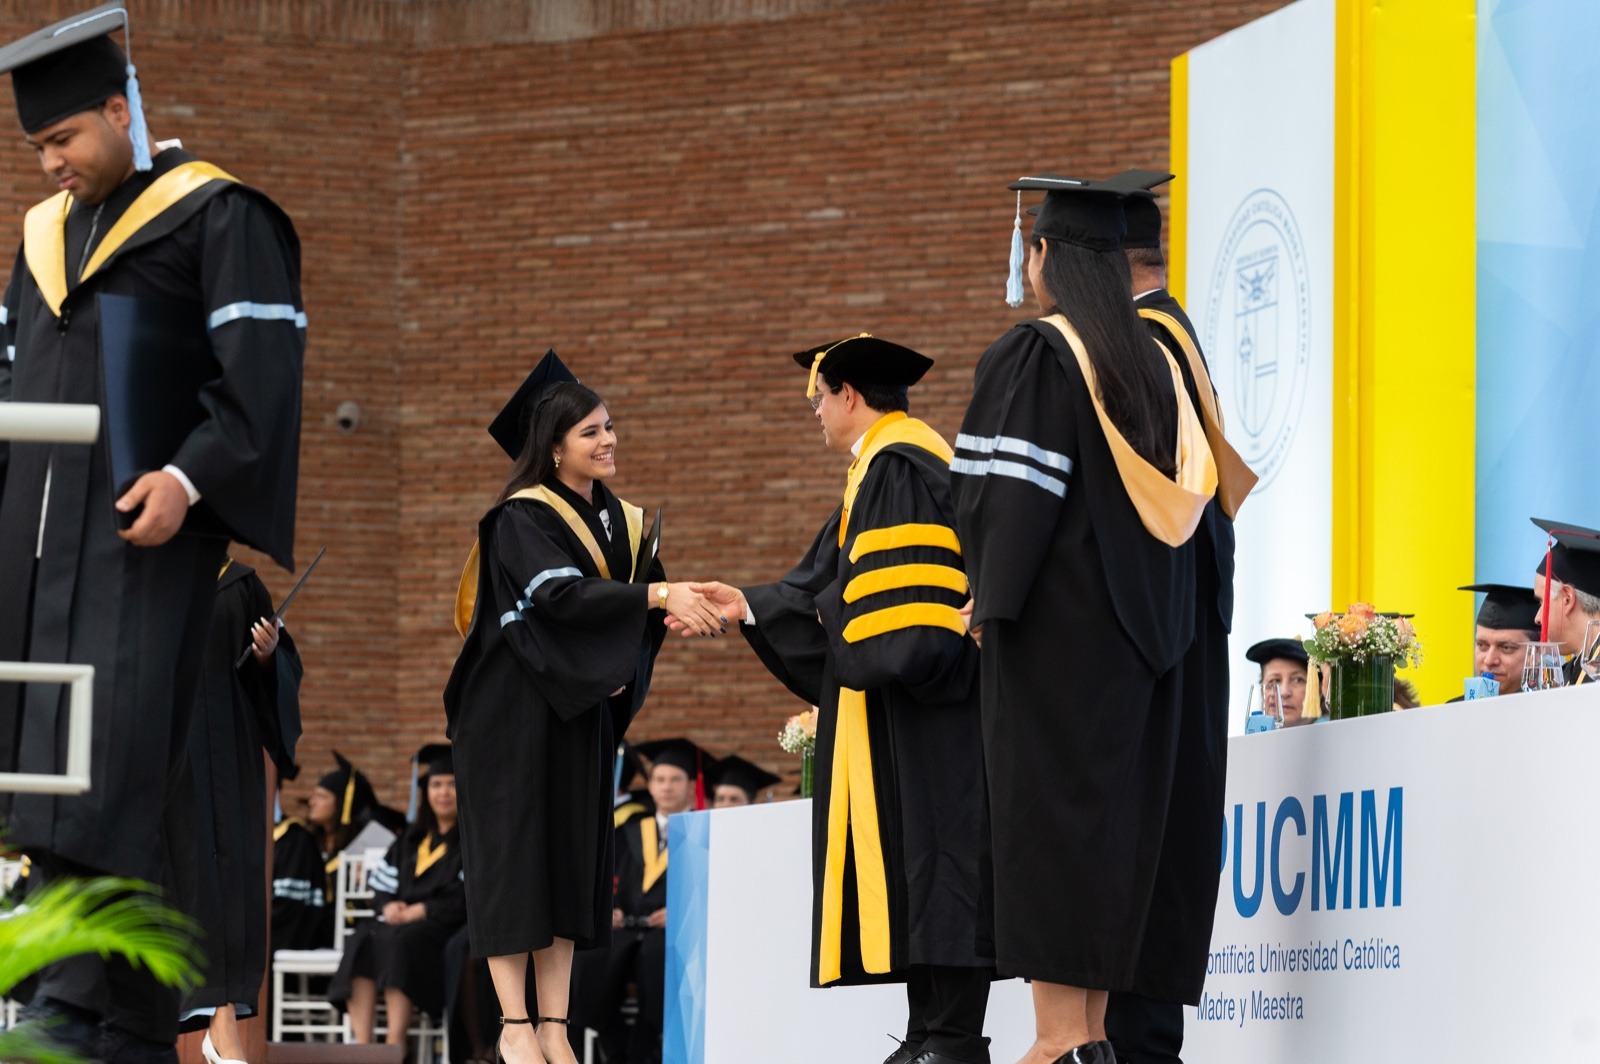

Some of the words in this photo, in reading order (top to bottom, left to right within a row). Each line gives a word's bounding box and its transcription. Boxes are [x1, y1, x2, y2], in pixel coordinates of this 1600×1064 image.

[1220, 786, 1403, 918] UCMM
[1207, 945, 1255, 975] ontificia
[1260, 940, 1338, 973] Universidad
[1343, 938, 1400, 970] Católica
[1197, 992, 1235, 1021] Madre
[1239, 999, 1247, 1028] y
[1251, 991, 1304, 1020] Maestra
